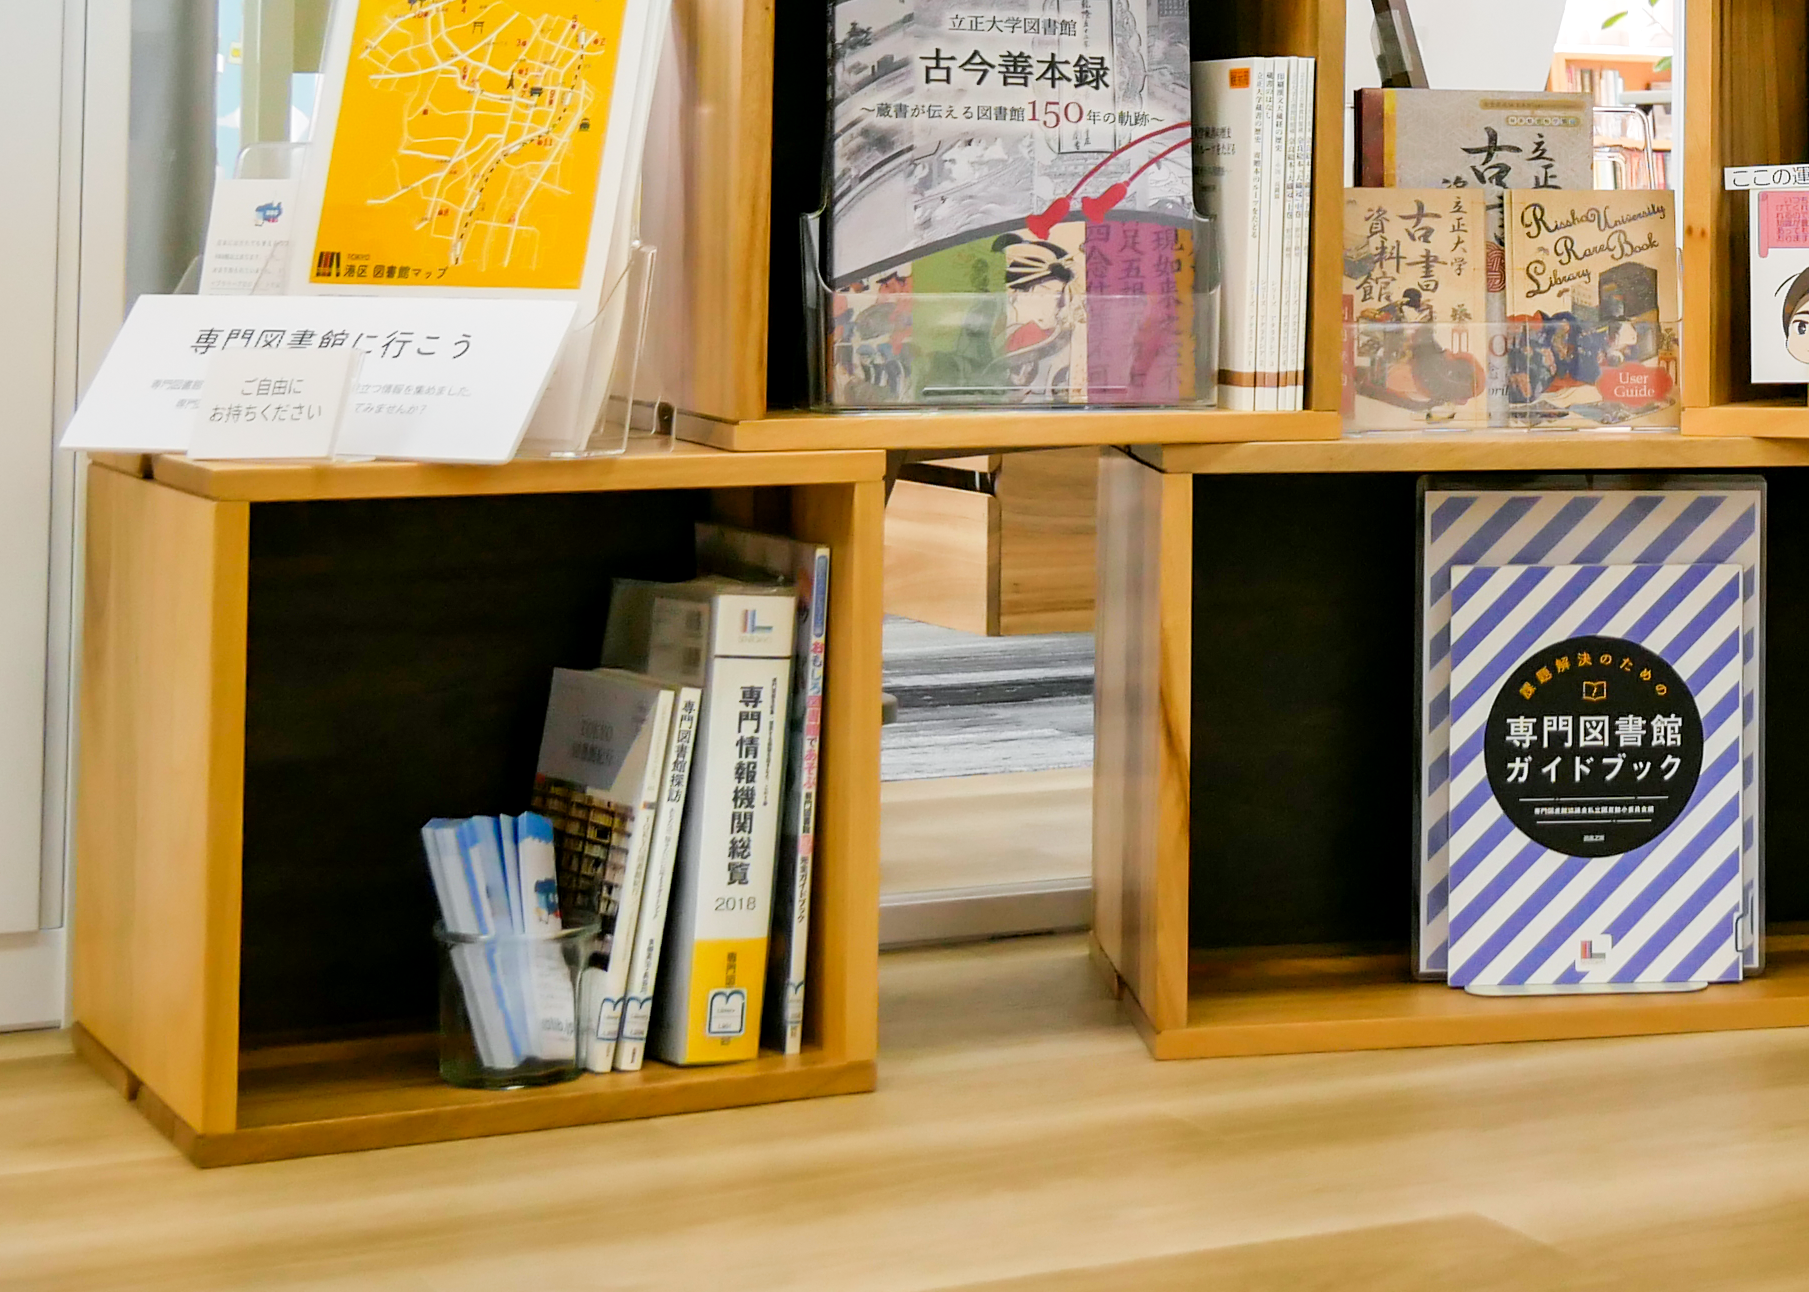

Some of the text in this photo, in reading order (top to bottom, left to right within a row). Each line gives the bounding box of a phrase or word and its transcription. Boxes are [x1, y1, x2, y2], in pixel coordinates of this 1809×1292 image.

[949, 15, 1077, 38] 立正大学図書館
[920, 50, 1110, 92] 古今善本録
[1449, 196, 1468, 276] 立正大学
[1520, 202, 1666, 239] Rissho University
[1356, 208, 1406, 303] 資料館
[1399, 199, 1448, 294] 古書
[1553, 229, 1659, 266] Rare Book
[343, 265, 449, 280] 港区 図書館マップ
[1525, 260, 1592, 298] Library
[240, 377, 304, 396] ご自由に
[1613, 385, 1655, 398] Guide
[1618, 373, 1649, 385] User
[208, 404, 323, 423] お持ちください
[1505, 714, 1683, 748] 専門図書館
[667, 699, 696, 803] 専門図書館探訪
[726, 685, 763, 886] 専門情報機関総覧
[1506, 754, 1682, 785] ガイドブック
[714, 896, 757, 913] 2018
